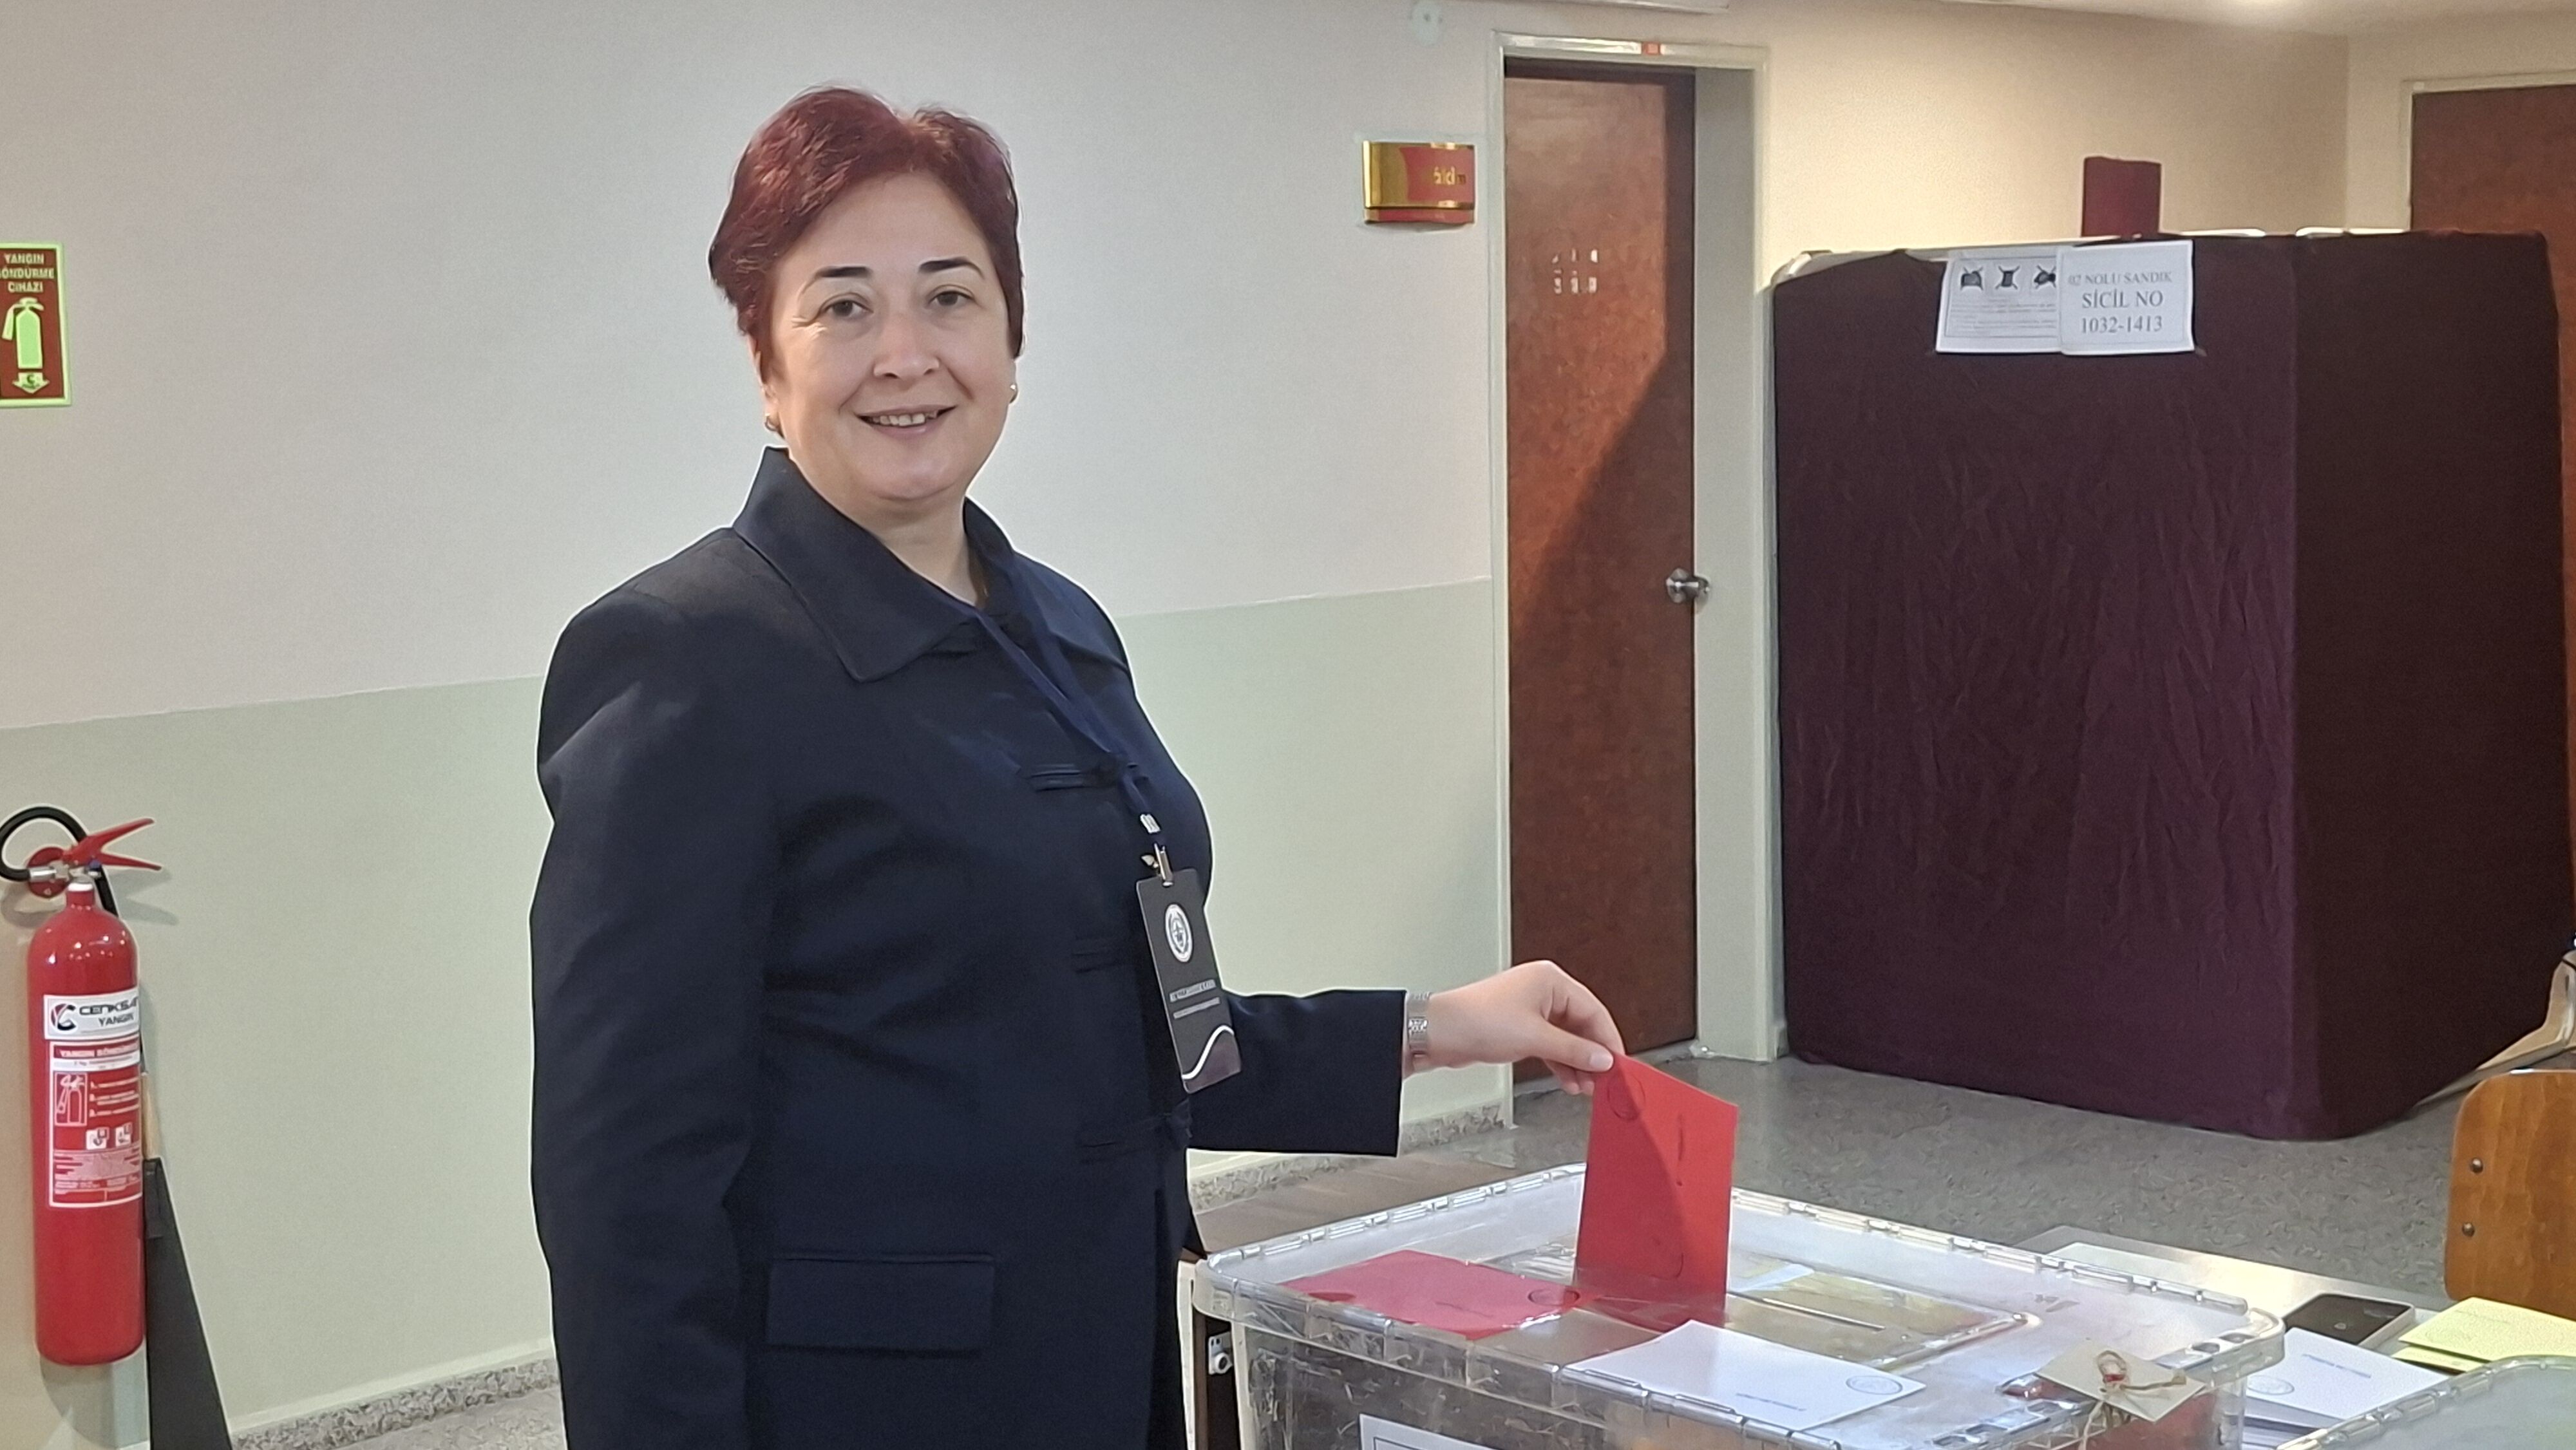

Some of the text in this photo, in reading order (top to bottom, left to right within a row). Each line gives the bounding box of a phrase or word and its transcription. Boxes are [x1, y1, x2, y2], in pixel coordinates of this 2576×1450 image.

[4, 252, 44, 265] YANGIN
[0, 265, 55, 279] ÖNDÜRME
[2085, 272, 2121, 284] NOLU
[2124, 271, 2172, 283] SANDIK
[2136, 290, 2163, 307] NO
[2082, 315, 2163, 334] 1032-1413
